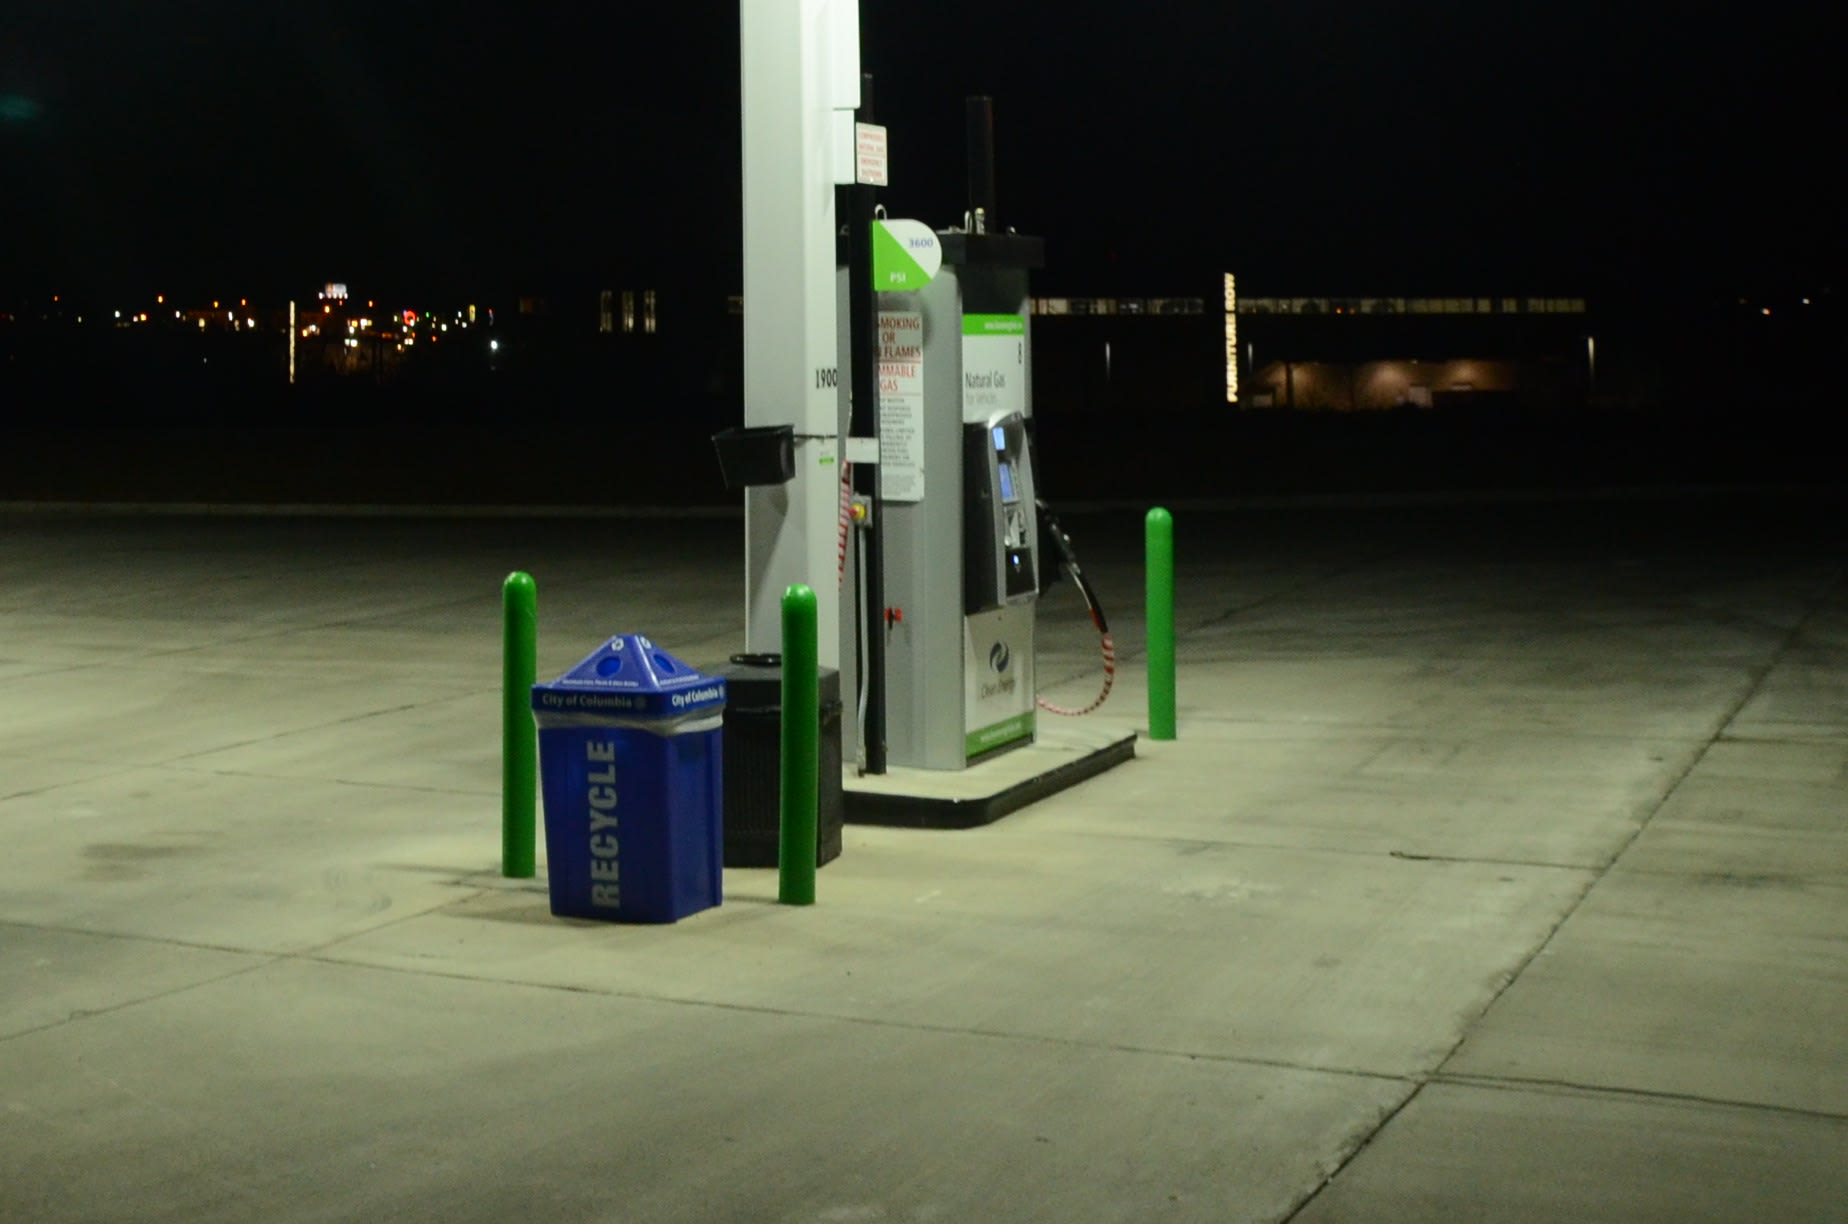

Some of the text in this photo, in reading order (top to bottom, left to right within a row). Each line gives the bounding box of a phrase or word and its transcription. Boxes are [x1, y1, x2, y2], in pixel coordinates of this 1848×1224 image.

[909, 238, 934, 249] 3600
[889, 271, 907, 284] PSI
[875, 316, 921, 329] MOKING
[881, 330, 896, 344] OR
[883, 345, 922, 358] FLAMES
[815, 367, 838, 390] 1900
[879, 379, 899, 392] GAS
[965, 369, 1006, 388] Natural Gas
[541, 693, 633, 708] City of Columbia
[671, 687, 719, 708] City of Columbia
[587, 740, 621, 909] RECYCLE
